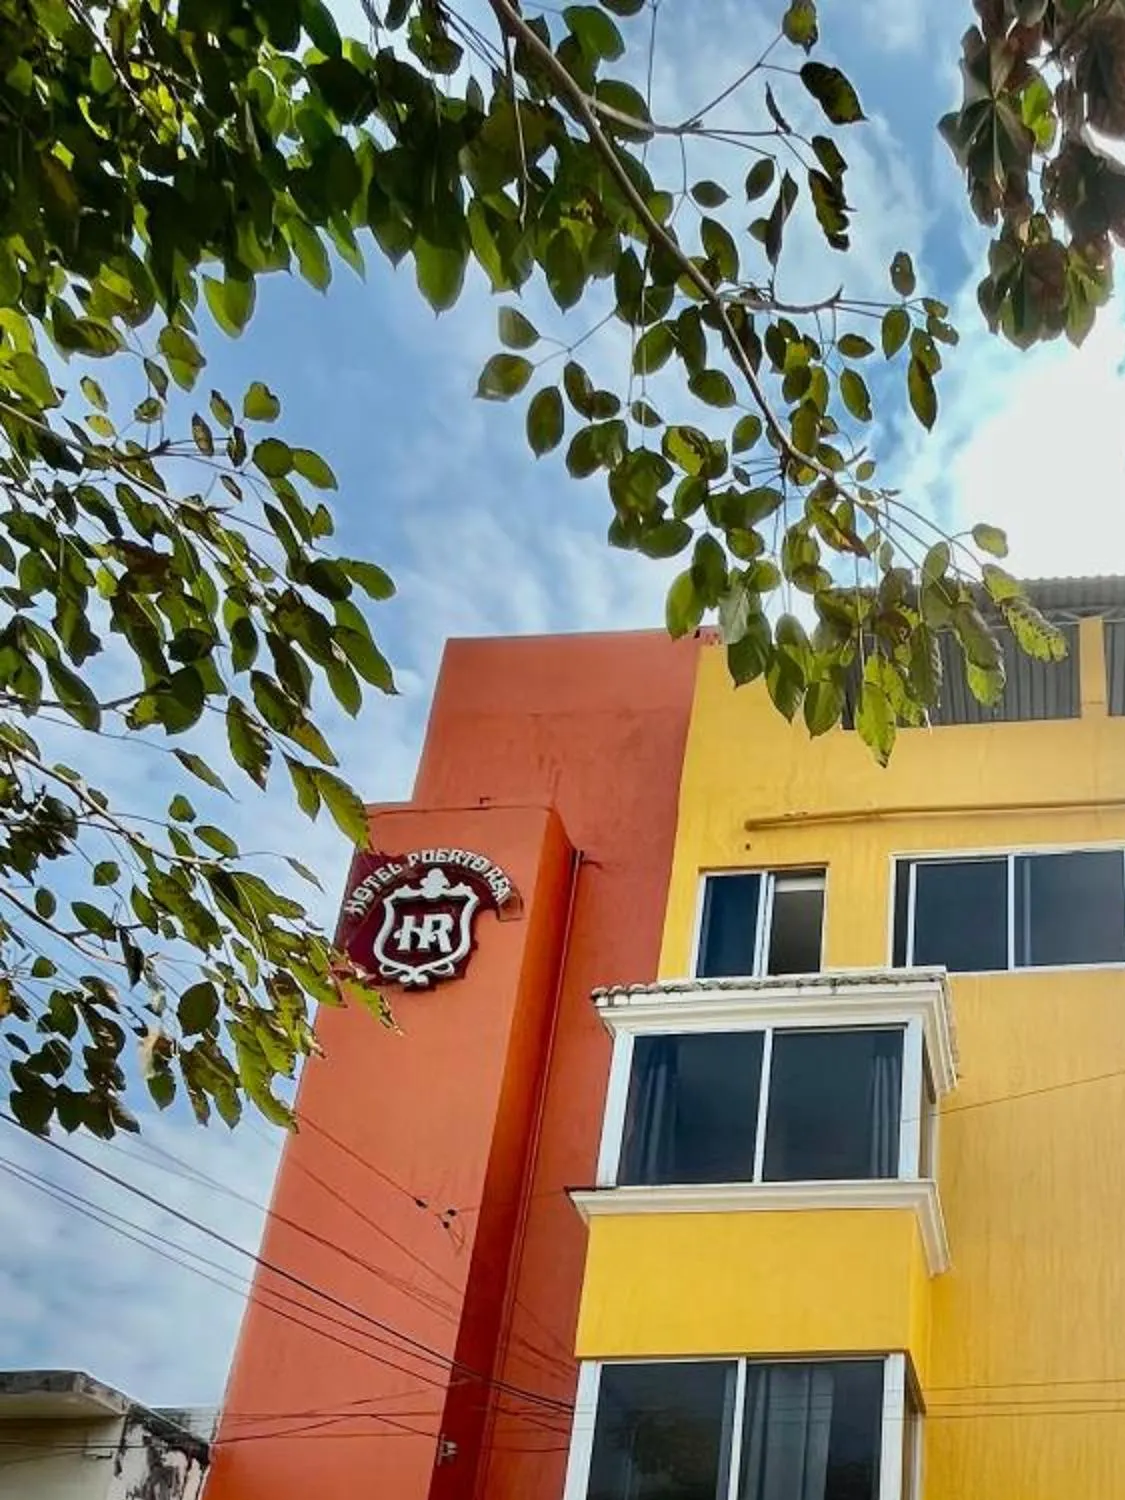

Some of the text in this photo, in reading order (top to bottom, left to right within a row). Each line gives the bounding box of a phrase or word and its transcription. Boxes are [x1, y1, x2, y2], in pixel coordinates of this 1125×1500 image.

[344, 863, 403, 917] HOTEL
[407, 848, 490, 874] PUERTO
[393, 914, 453, 953] HR
